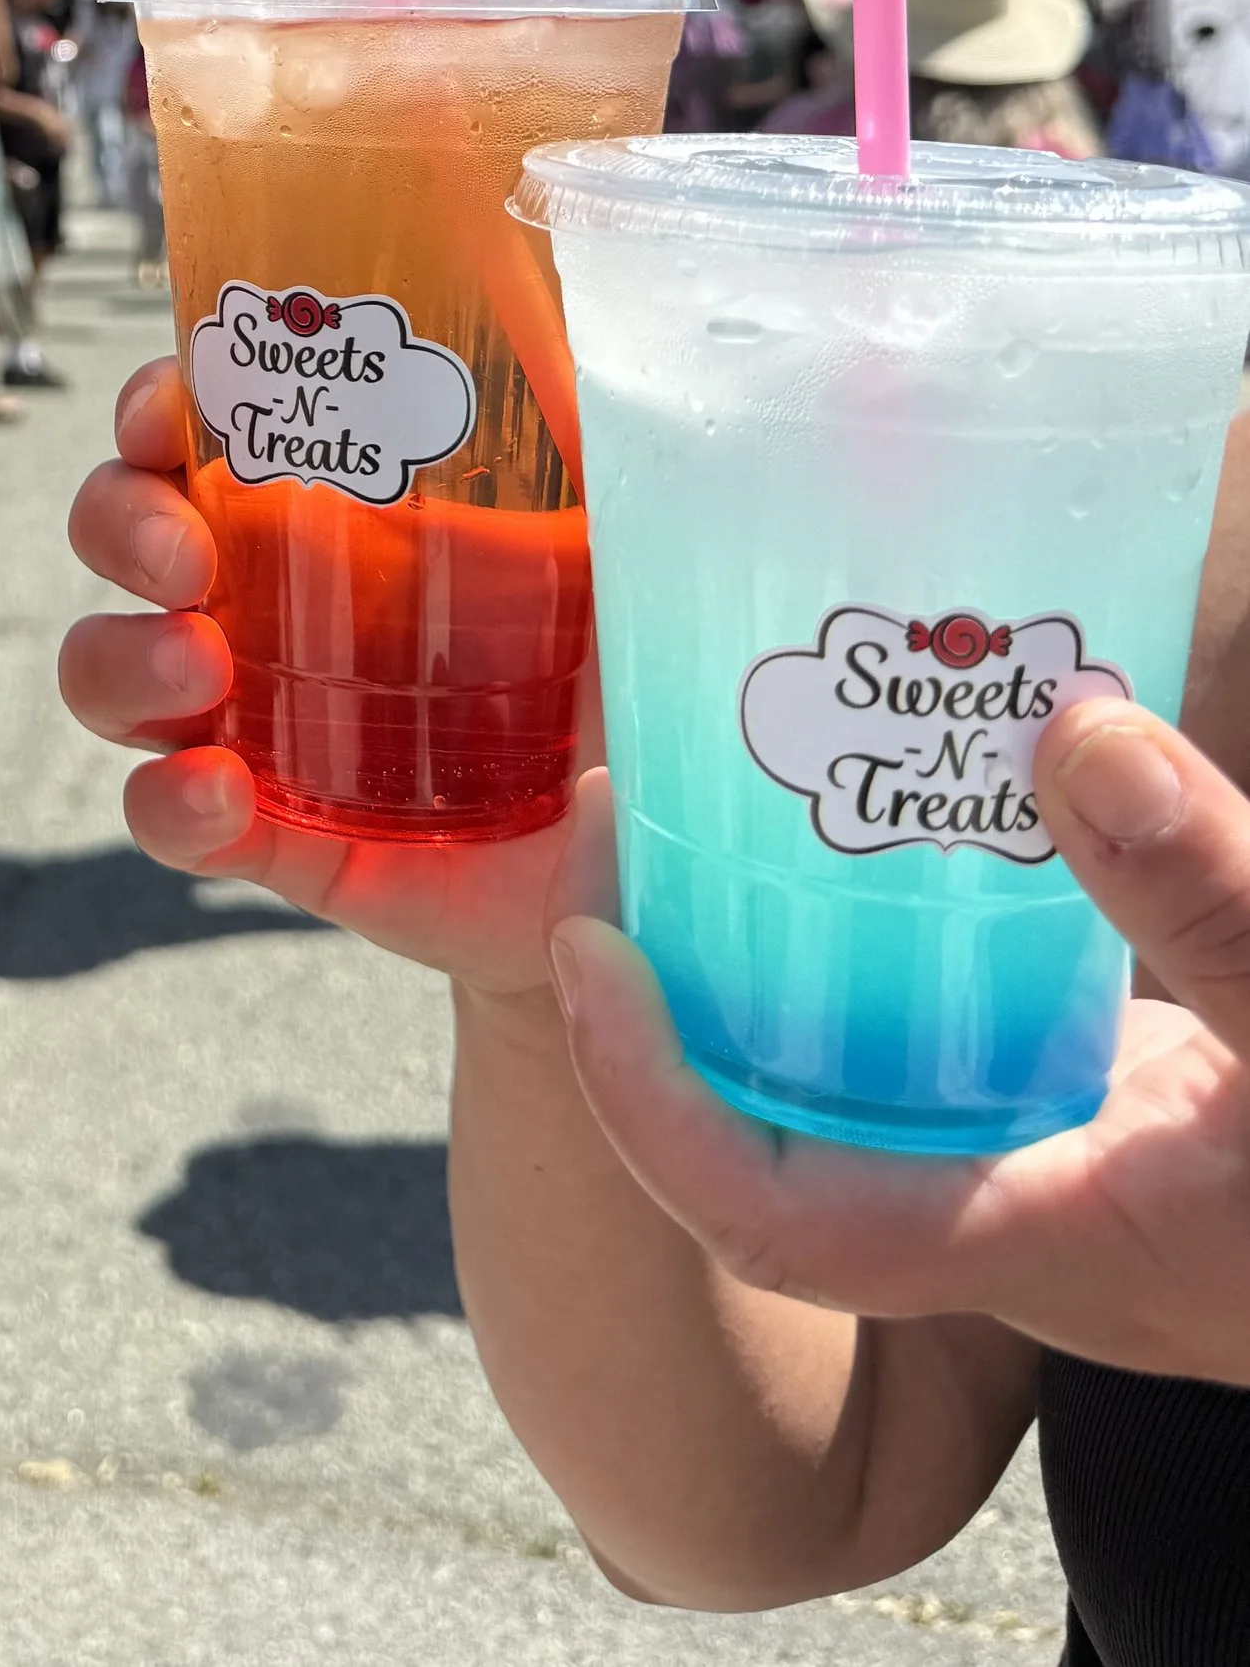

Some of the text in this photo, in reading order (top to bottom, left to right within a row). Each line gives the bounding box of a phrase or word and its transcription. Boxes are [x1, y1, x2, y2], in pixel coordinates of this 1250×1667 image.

[230, 312, 386, 384] Sweets
[231, 402, 382, 476] Treats
[272, 386, 339, 427] -N-
[834, 641, 1058, 721] Sweets
[904, 728, 999, 781] -N-
[826, 753, 1040, 833] Treats
